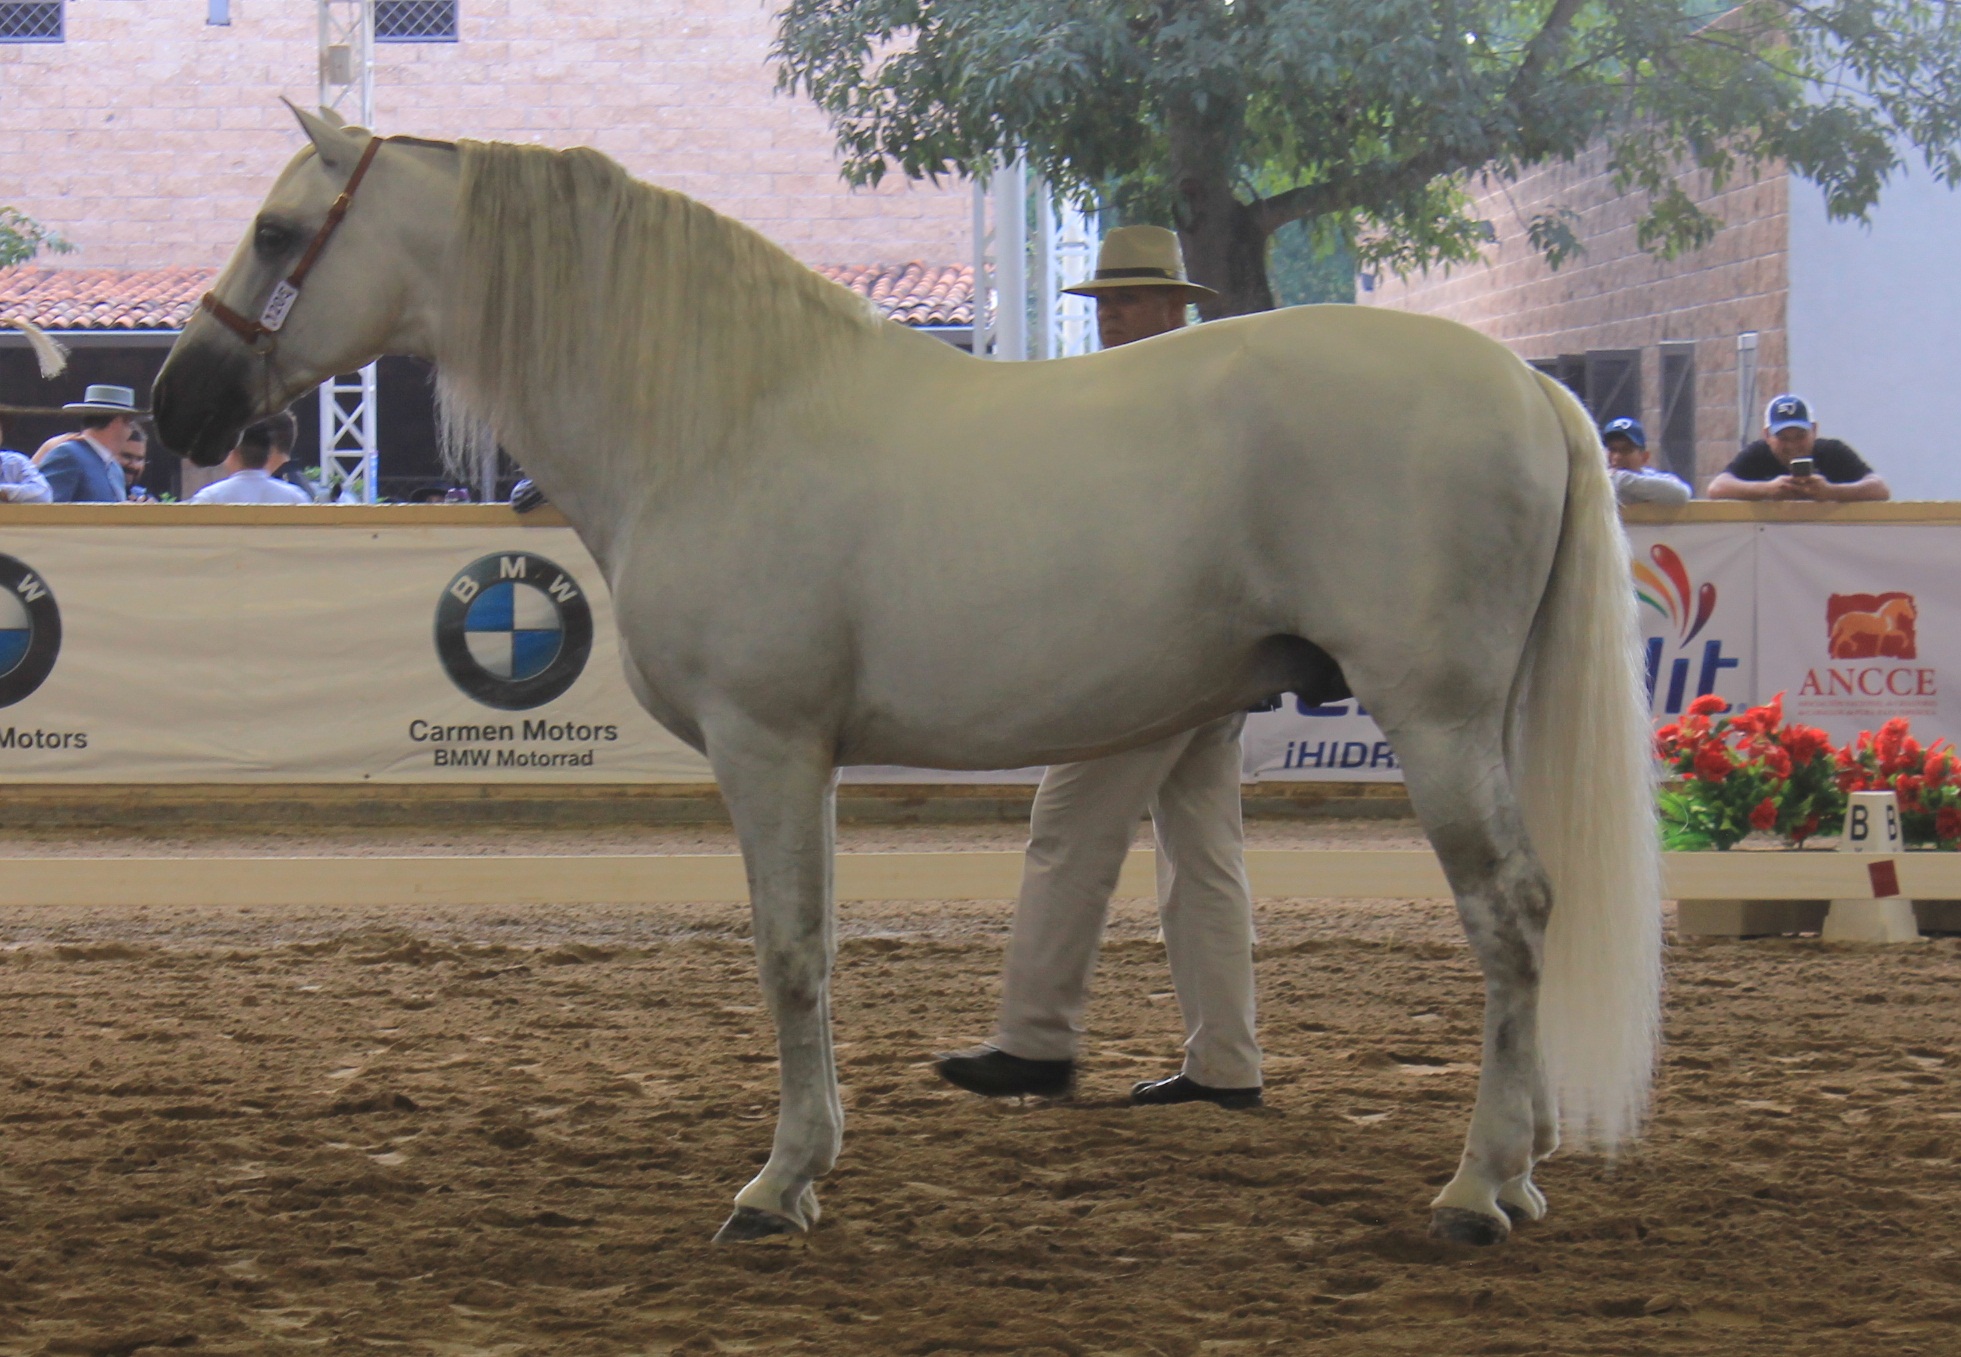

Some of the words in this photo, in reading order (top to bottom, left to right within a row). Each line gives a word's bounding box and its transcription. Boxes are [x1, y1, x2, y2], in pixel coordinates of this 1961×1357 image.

[451, 556, 578, 604] BMW
[1798, 667, 1937, 696] ANCCE
[409, 719, 514, 741] Carmen
[522, 719, 618, 741] Motors
[434, 749, 490, 766] BMW
[496, 749, 594, 766] Motorrad
[1850, 804, 1868, 841] B
